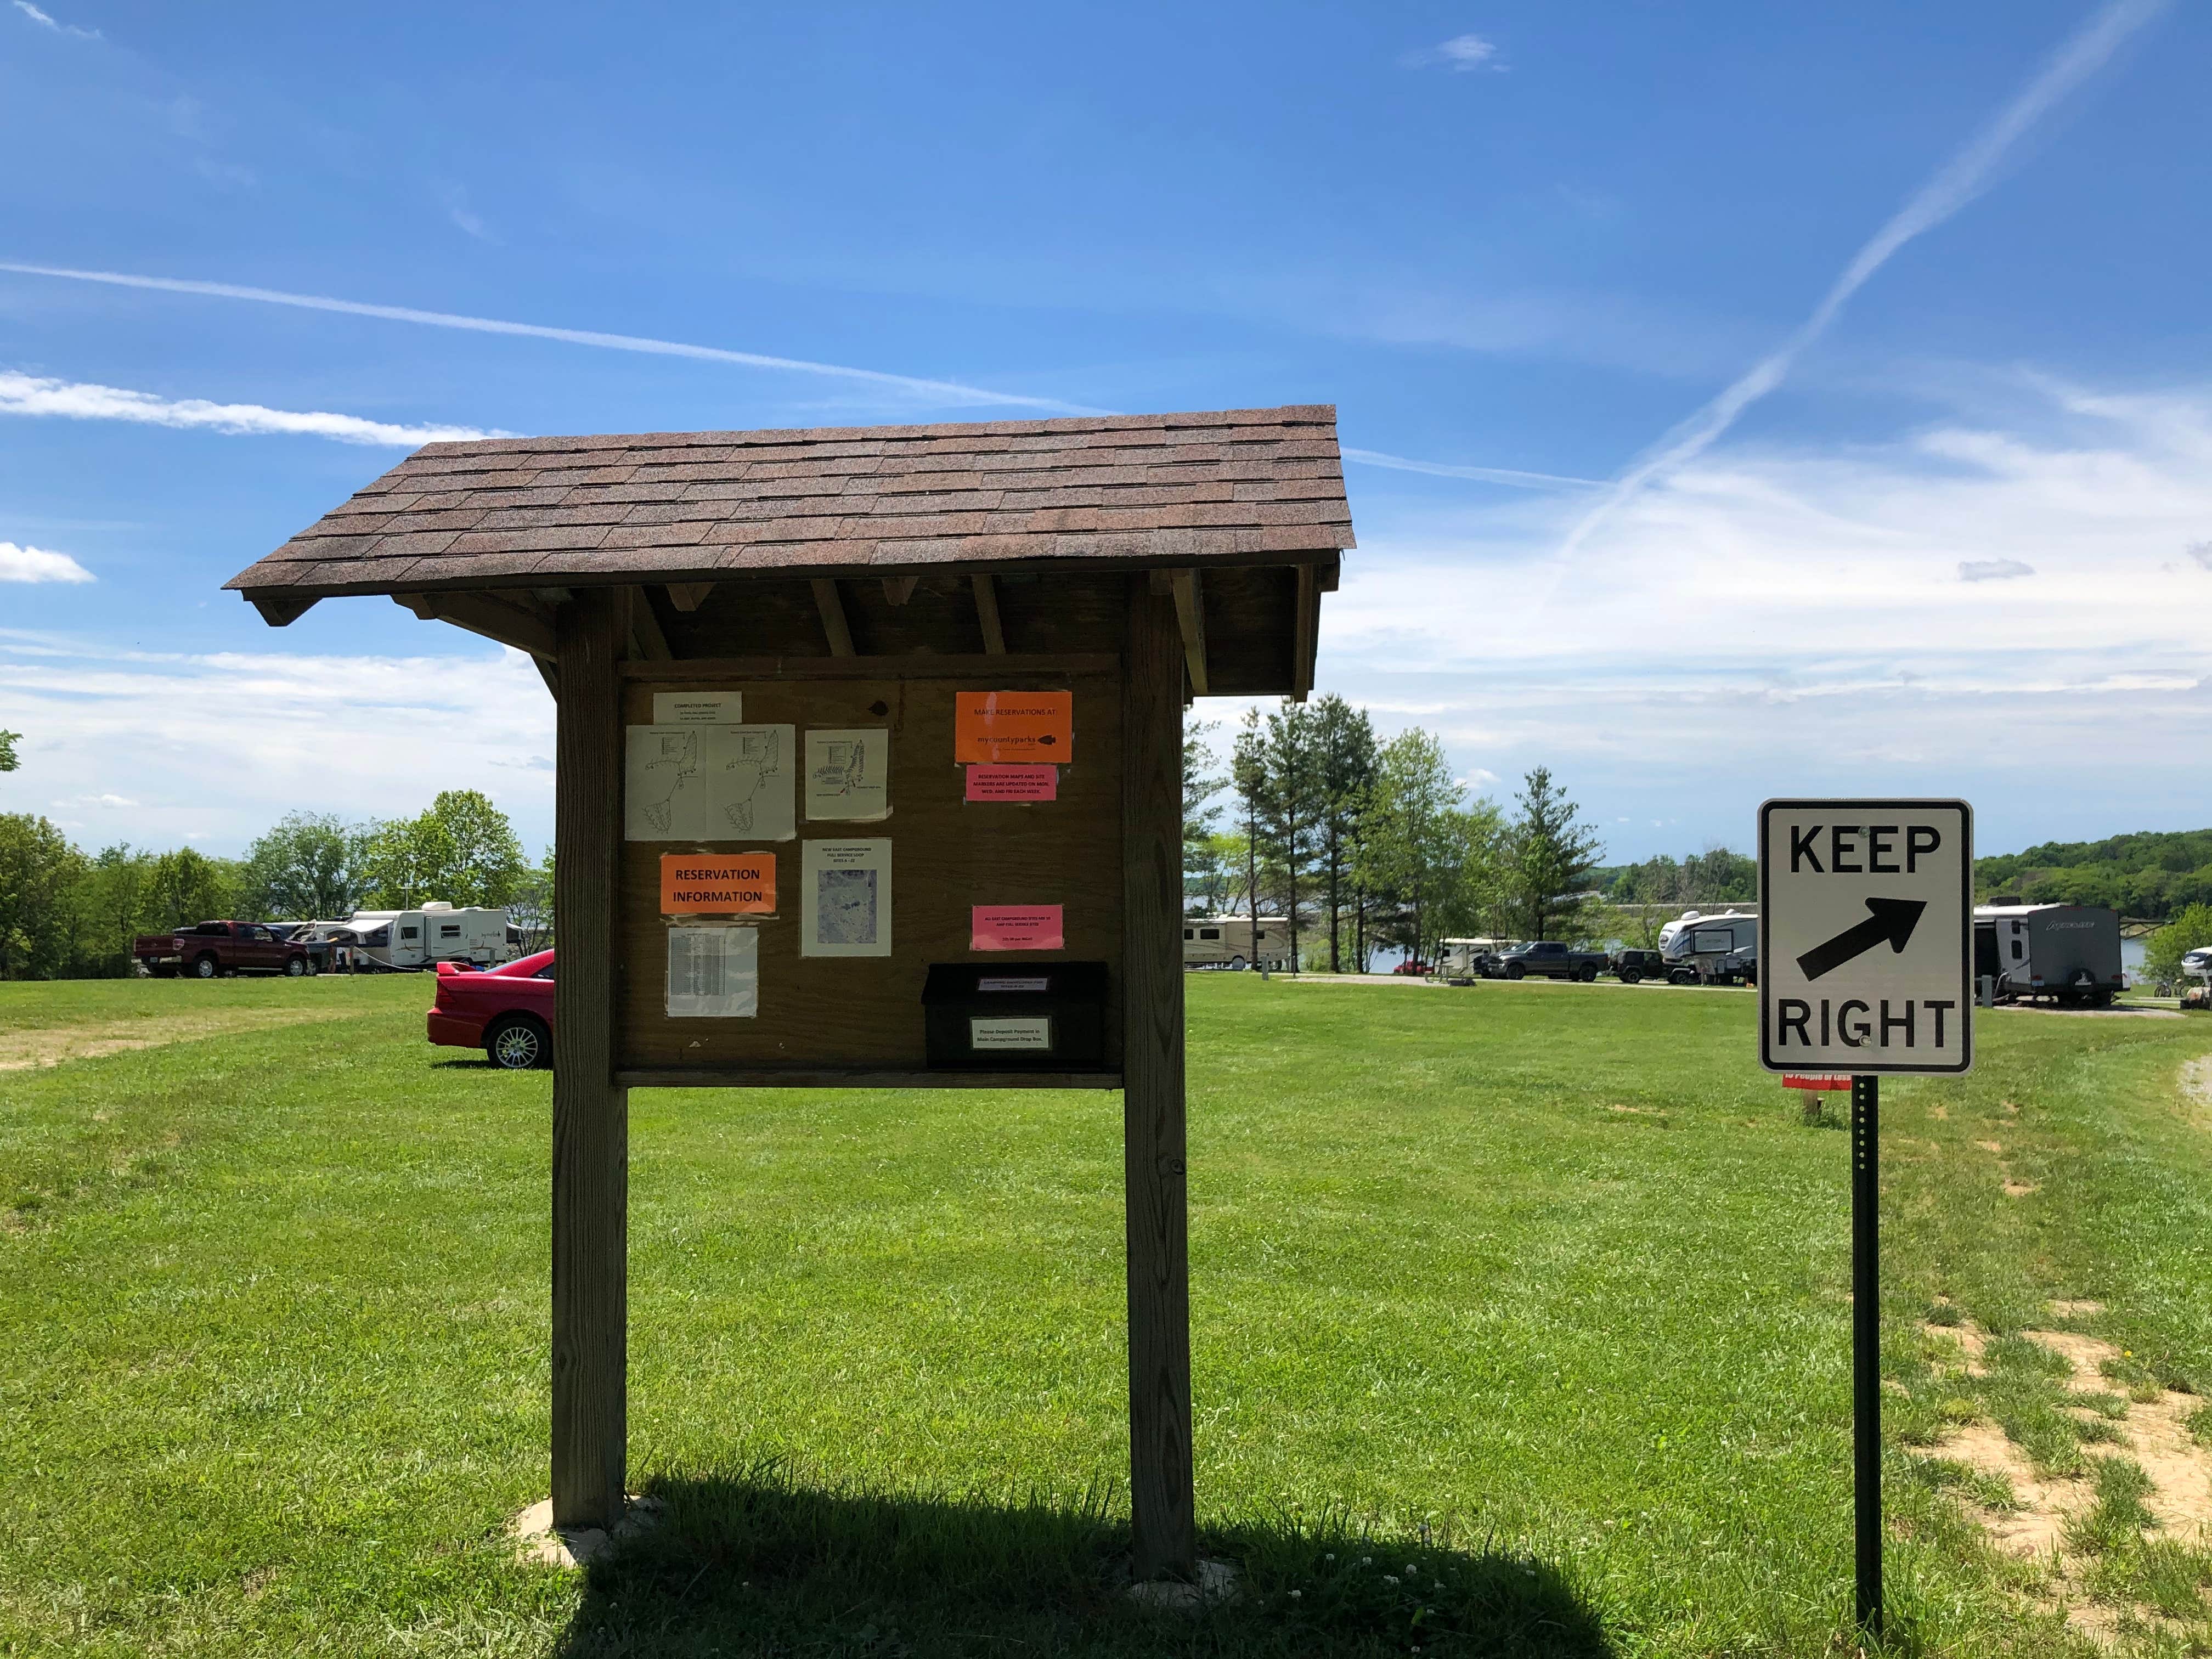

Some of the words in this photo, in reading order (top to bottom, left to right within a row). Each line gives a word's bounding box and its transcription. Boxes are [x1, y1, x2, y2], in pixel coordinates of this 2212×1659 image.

[978, 736, 1036, 744] mycountyparks
[1791, 826, 1941, 873] KEEP
[676, 870, 760, 880] RESERVATION
[673, 891, 762, 902] INFORMATION
[1778, 999, 1955, 1047] RIGHT
